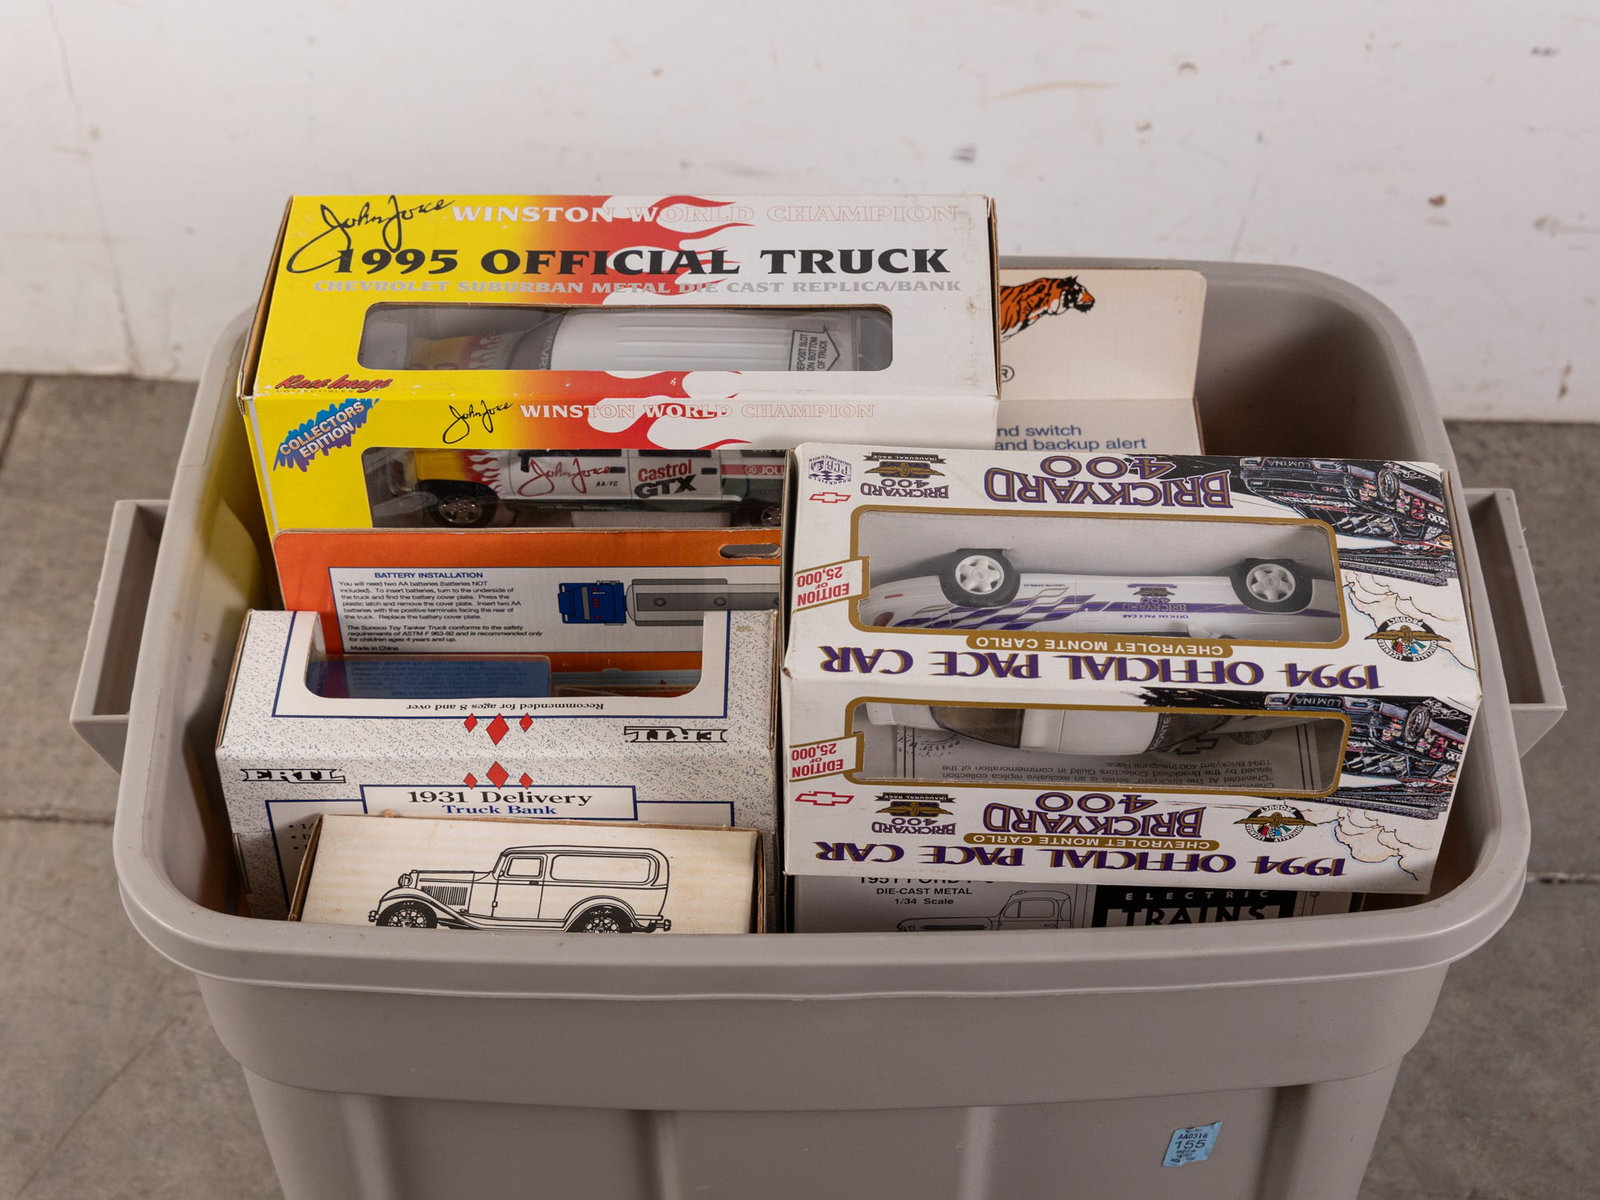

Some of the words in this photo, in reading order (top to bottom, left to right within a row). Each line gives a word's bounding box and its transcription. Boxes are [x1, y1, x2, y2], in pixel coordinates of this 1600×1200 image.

[452, 206, 614, 223] WINSTON
[627, 205, 755, 223] WORLD
[766, 205, 960, 222] CHAMPION
[334, 248, 459, 275] 1995
[480, 248, 740, 275] OFFICIAL
[760, 248, 950, 274] TRUCK
[313, 280, 451, 292] CHEVROLET
[457, 281, 584, 293] SUBURBAN
[591, 282, 671, 294] METAL
[678, 282, 719, 294] DIE
[726, 281, 785, 293] CAST
[791, 280, 962, 292] REPLICA/BANK
[799, 332, 808, 348] SLOT
[807, 336, 817, 361] BOTTOM
[817, 339, 828, 359] TRUCK
[817, 359, 826, 370] OF
[275, 374, 332, 390] Race
[327, 374, 394, 393] Image
[520, 405, 635, 418] WINSTON
[643, 404, 734, 418] WORLD
[740, 404, 875, 418] CHAMPION
[279, 401, 365, 456] COLLECTORS
[997, 425, 1019, 437] nd
[1025, 424, 1082, 437] switch
[298, 421, 356, 458] EDITION
[994, 438, 1028, 451] and
[1033, 438, 1100, 452] backup
[1106, 437, 1147, 449] alert
[637, 459, 693, 482] Castrol
[1040, 455, 1176, 480] 400
[1265, 458, 1312, 469] LUMINA
[633, 474, 697, 499] GTX
[860, 482, 949, 499] BRICKYARD
[880, 479, 930, 489] 400
[984, 466, 1234, 508] BRICKYARD
[796, 566, 843, 588] 25,000
[814, 582, 828, 590] OF
[797, 583, 850, 607] EDITION
[1385, 616, 1424, 627] PRODUCT
[976, 636, 1038, 649] CARLO
[1045, 638, 1107, 651] MONTE
[1113, 641, 1223, 655] CHEVROLET
[817, 646, 913, 674] CAR
[928, 651, 1042, 678] PACE
[1052, 655, 1264, 685] OFFICIAL
[1276, 661, 1384, 689] 1994
[434, 703, 457, 711] and
[459, 703, 468, 711] 8
[471, 702, 497, 711] ages
[499, 703, 516, 711] for
[519, 702, 604, 711] Recommended
[1293, 696, 1341, 708] LUMINA
[624, 726, 728, 743] ERTL
[791, 743, 837, 761] 25,000
[240, 768, 346, 783] ERTL
[791, 758, 844, 778] EDITION
[407, 790, 465, 803] 1931
[480, 790, 593, 805] Delivery
[1035, 792, 1158, 814] 400
[442, 804, 501, 814] Truck
[507, 805, 557, 815] Bank
[891, 818, 938, 826] 400
[982, 802, 1207, 838] BRICKYARD
[871, 821, 956, 835] BRICKYARD
[974, 834, 1033, 844] CARLO
[1039, 836, 1099, 847] MONTE
[1105, 838, 1210, 850] CHEVROLET
[813, 841, 905, 863] CAR
[918, 845, 1025, 867] PACE
[1035, 848, 1236, 873] OFFICIAL
[1248, 855, 1347, 877] 1994
[876, 887, 931, 895] DIE-CAST
[933, 887, 973, 895] METAL
[1125, 890, 1268, 901] ELECTRIC
[1121, 905, 1266, 926] TRAINS
[1175, 1139, 1207, 1150] 155
